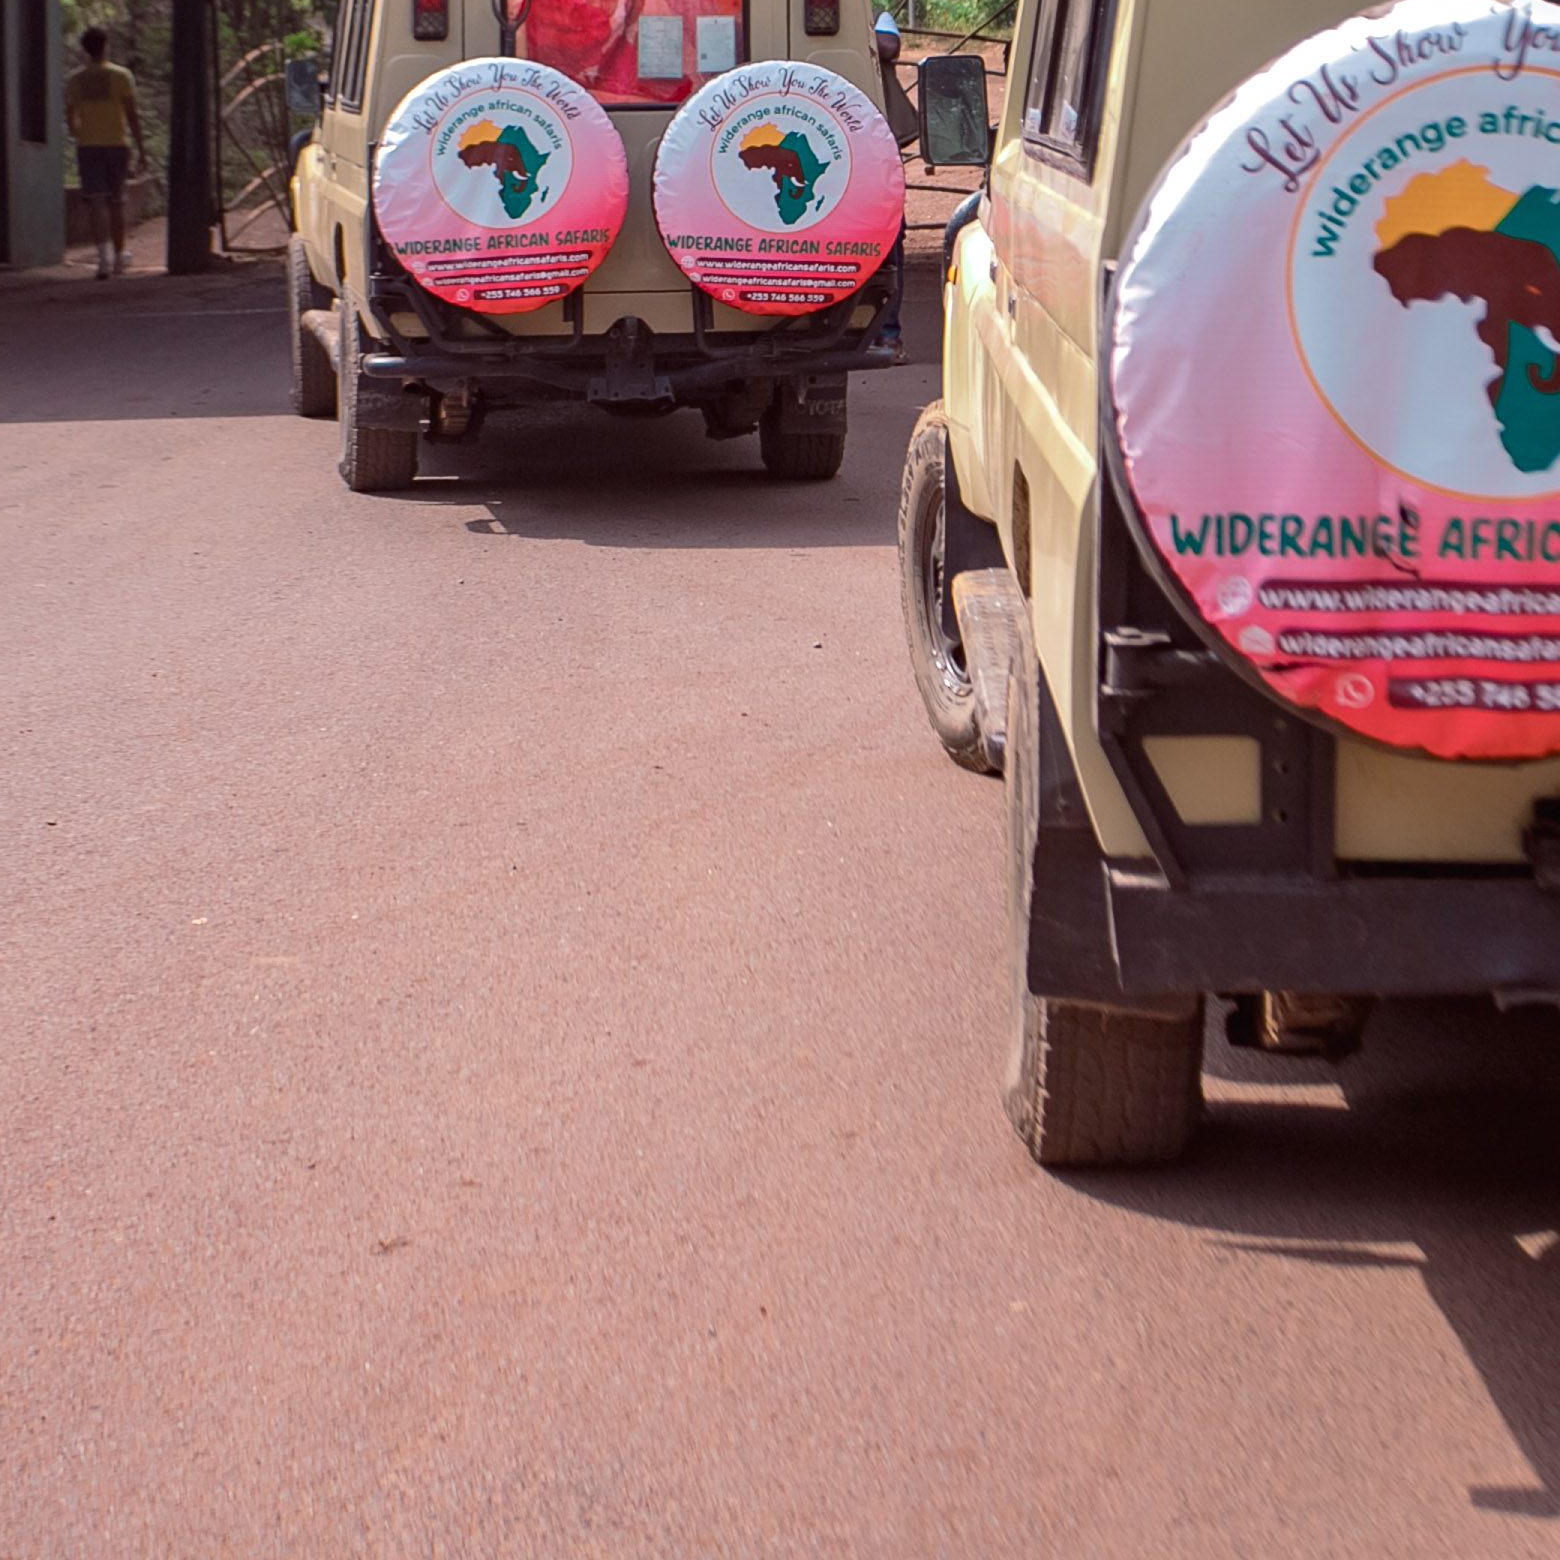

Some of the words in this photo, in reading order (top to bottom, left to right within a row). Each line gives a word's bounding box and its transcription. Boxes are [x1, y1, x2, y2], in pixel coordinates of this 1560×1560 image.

[436, 102, 486, 155] widerange
[488, 100, 532, 117] african
[533, 115, 562, 150] safaris
[697, 108, 723, 132] Let
[713, 89, 737, 110] Us
[732, 74, 771, 98] Show
[778, 67, 806, 97] You
[808, 76, 830, 100] The
[831, 91, 864, 133] World
[1241, 114, 1321, 193] Let
[1288, 63, 1360, 124] Us
[1351, 22, 1468, 85] Show
[718, 107, 771, 154] widerange
[773, 104, 816, 126] african
[816, 124, 842, 160] safaris
[1311, 115, 1468, 257] widerange
[393, 236, 482, 256] WIDERANGE
[486, 233, 549, 251] AFRICAN
[555, 229, 611, 246] SAFARIS
[666, 234, 753, 252] WIDERANGE
[758, 238, 820, 255] AFRICAN
[825, 241, 881, 257] SAFARIS
[696, 259, 857, 273] www.widerangeafricansafaris.com
[1171, 514, 1420, 559] WIDERANGE
